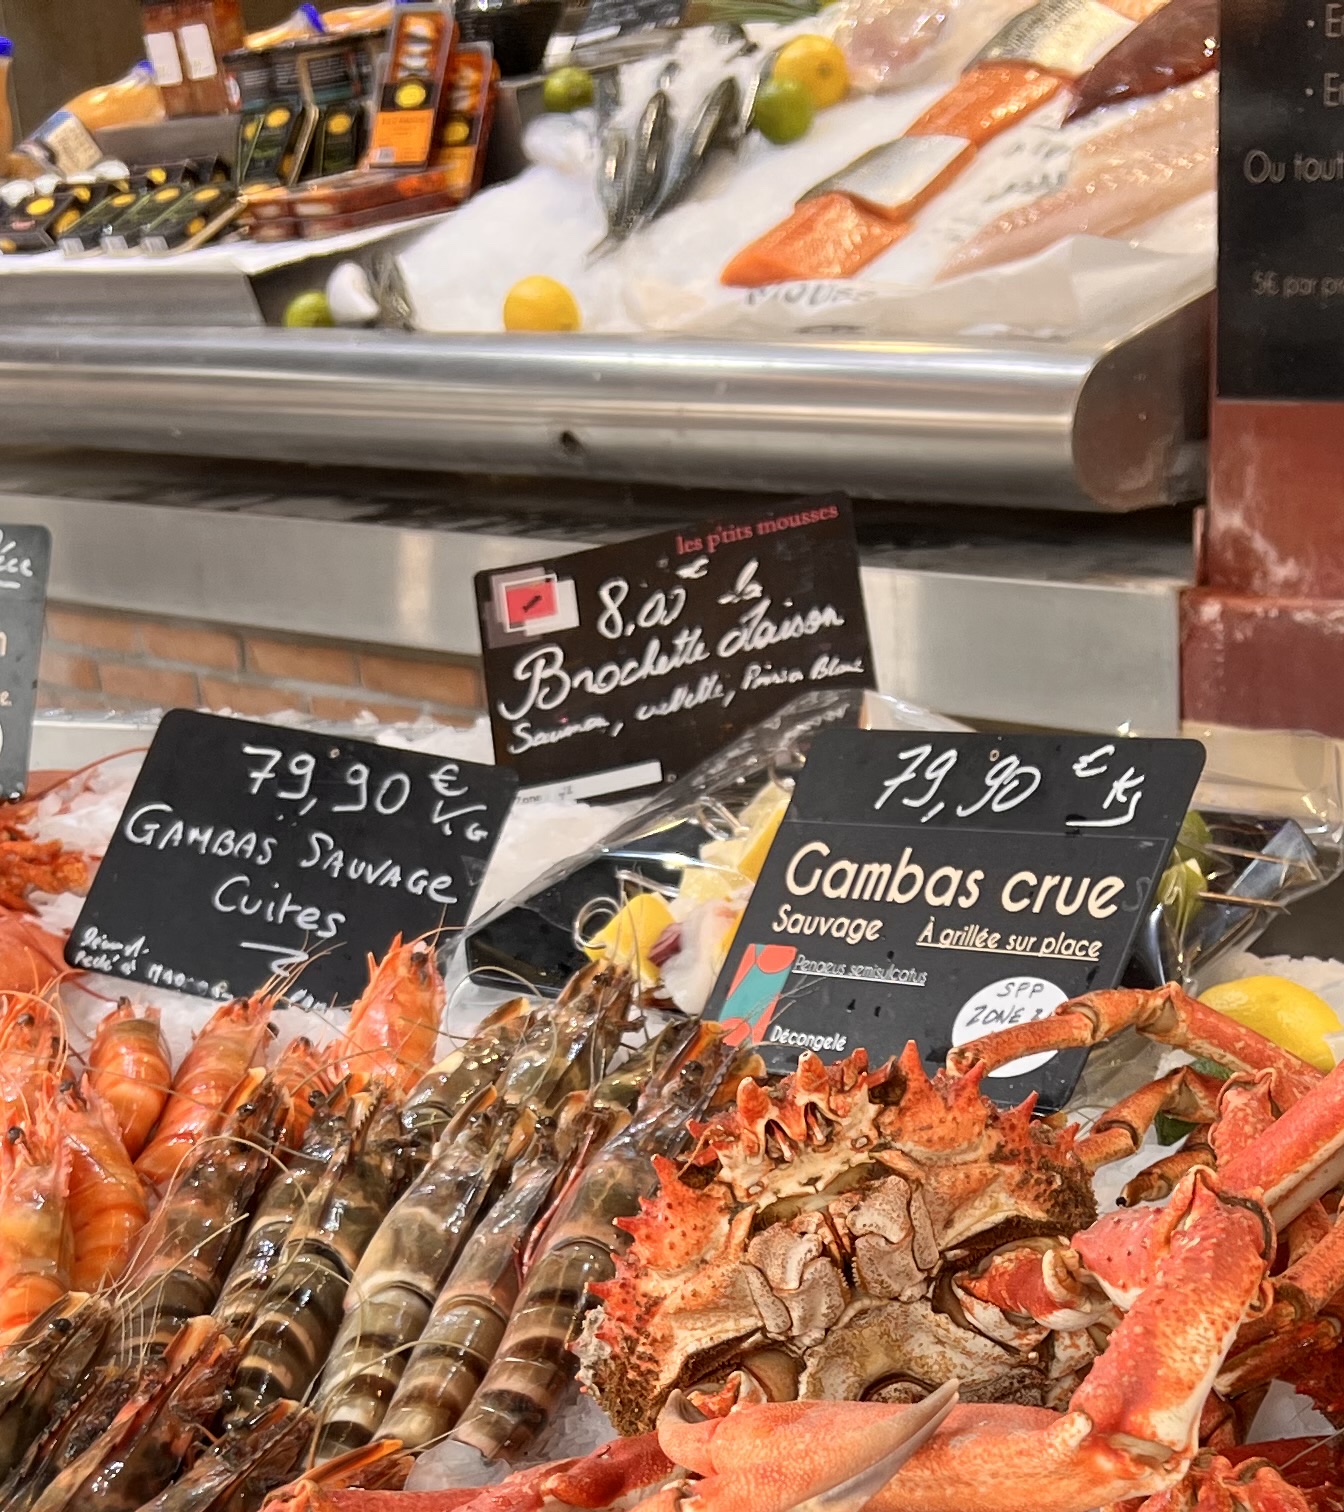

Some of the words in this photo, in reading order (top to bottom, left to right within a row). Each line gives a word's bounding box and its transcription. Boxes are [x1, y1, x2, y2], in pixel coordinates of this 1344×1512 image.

[1244, 150, 1285, 184] Ou
[1294, 150, 1344, 182] tout
[675, 535, 704, 556] les
[705, 524, 754, 554] p'tits
[757, 503, 839, 538] mousses
[242, 745, 412, 817] 79,90
[428, 763, 469, 797] €
[874, 745, 1042, 823] 79,90
[211, 873, 347, 940] Cuites
[785, 841, 985, 909] Gambas
[1002, 869, 1127, 920] crue
[772, 904, 884, 945] Sauvage
[1006, 936, 1037, 954] sur
[1039, 932, 1104, 960] place
[965, 1004, 1025, 1027] ZONE
[997, 981, 1045, 999] SPP
[769, 1025, 847, 1052] Décongelé
